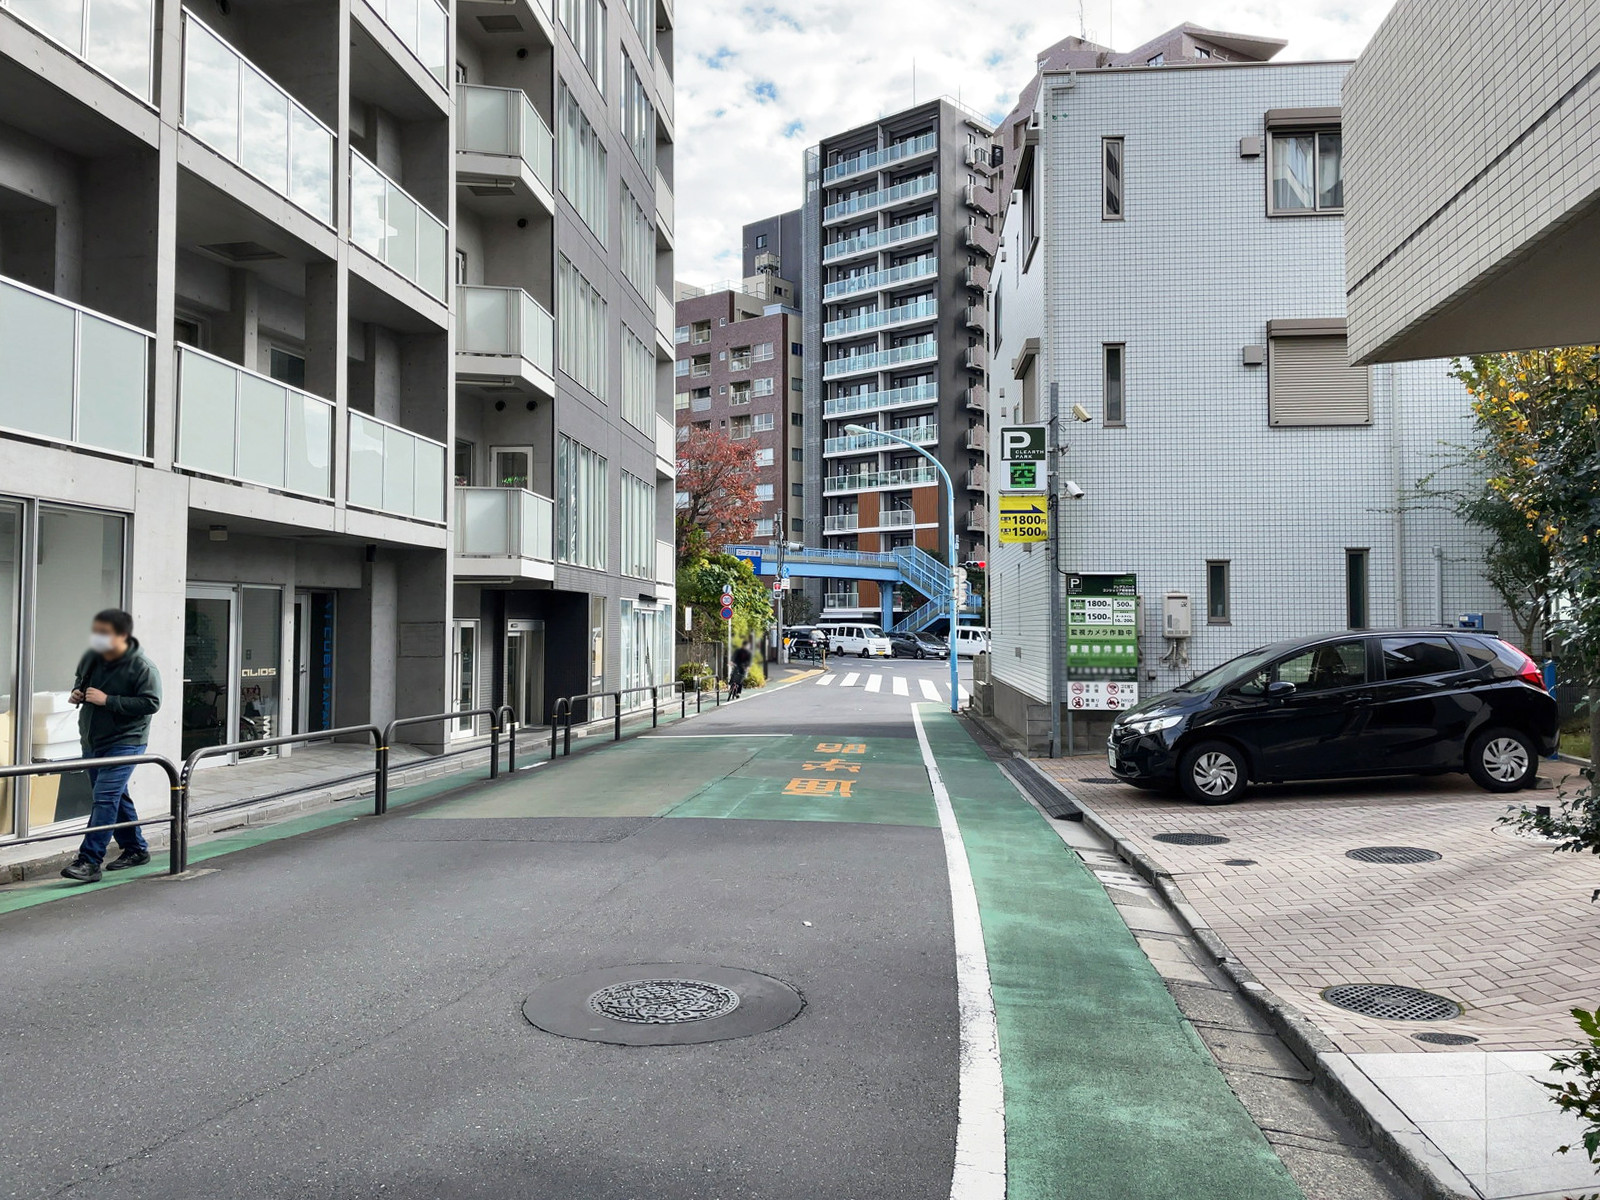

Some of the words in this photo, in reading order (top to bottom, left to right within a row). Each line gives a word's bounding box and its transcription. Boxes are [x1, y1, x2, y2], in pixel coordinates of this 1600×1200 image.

[1002, 431, 1031, 460] P
[1010, 462, 1036, 488] 空
[1070, 578, 1080, 588] P
